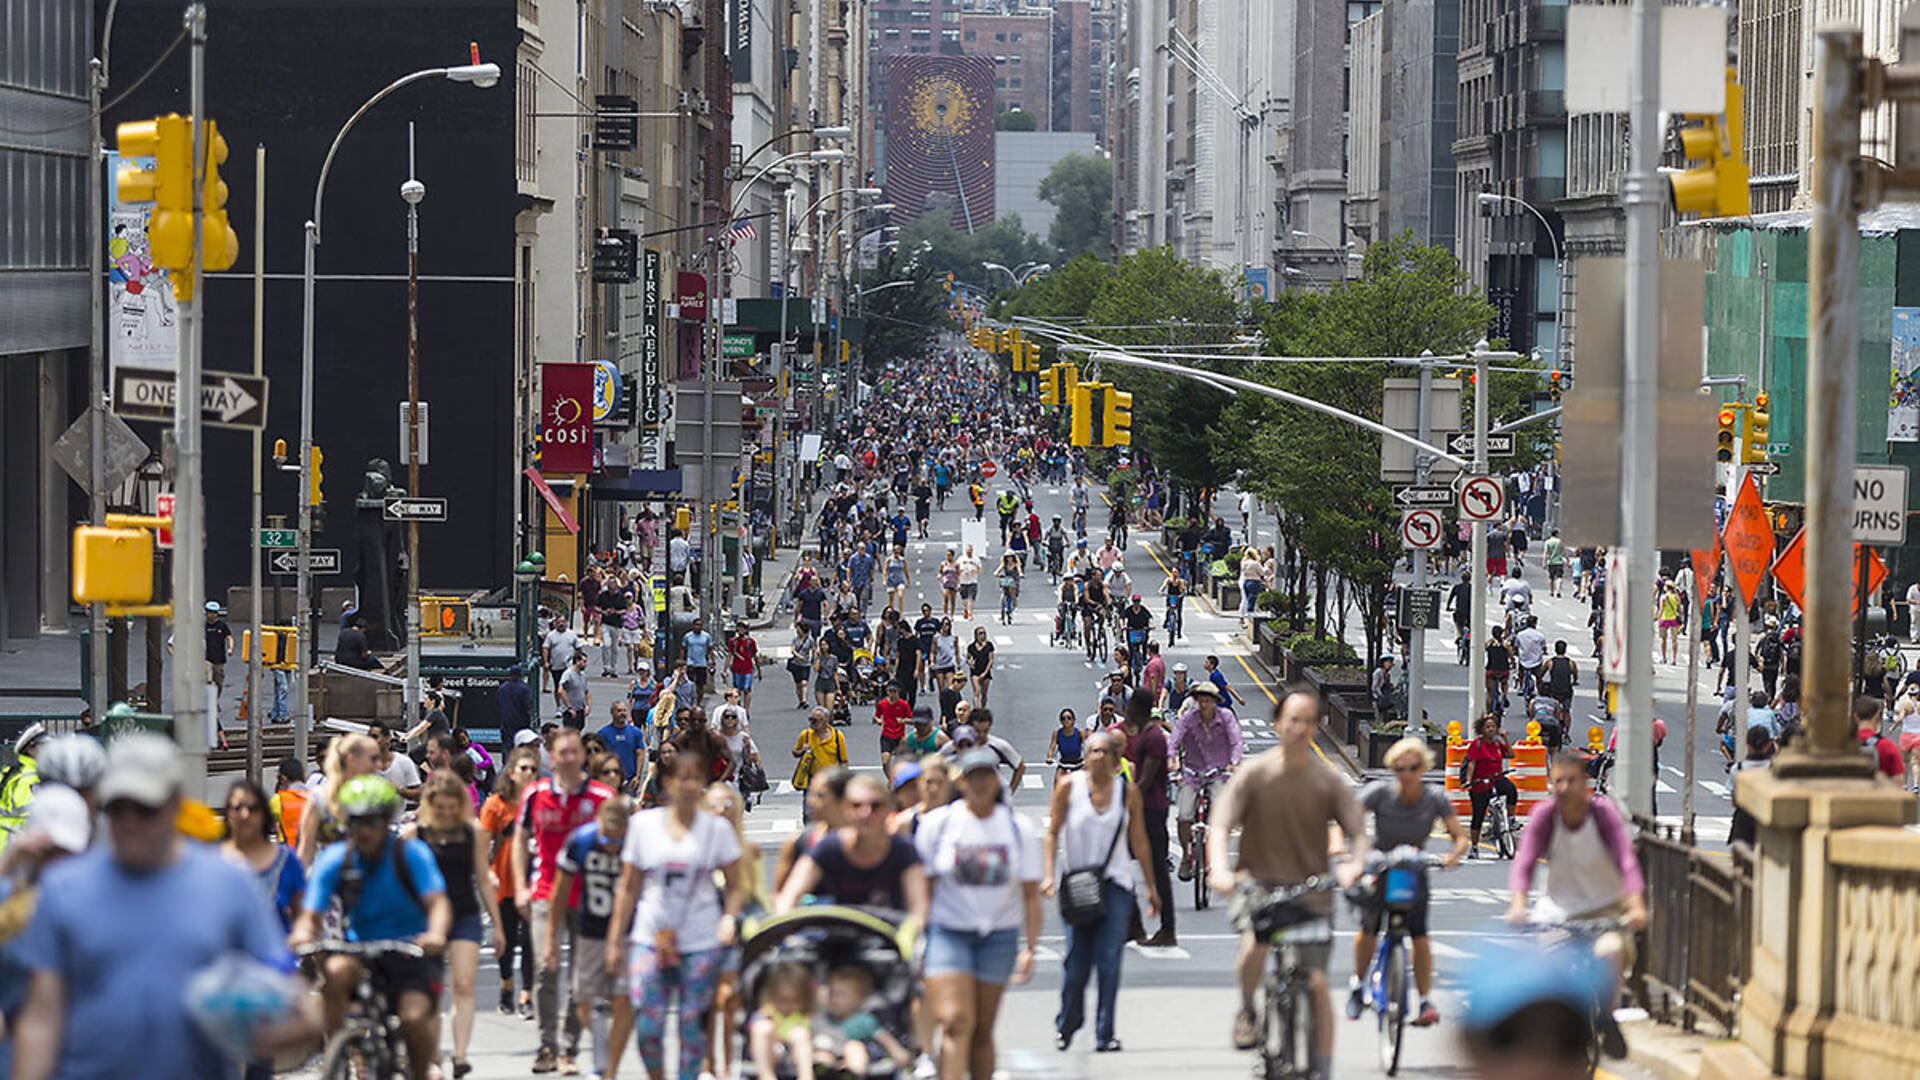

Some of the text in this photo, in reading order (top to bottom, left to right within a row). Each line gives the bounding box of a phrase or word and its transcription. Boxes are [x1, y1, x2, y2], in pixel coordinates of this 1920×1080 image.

[645, 253, 657, 317] FIRST
[643, 324, 658, 422] REPUBLIC
[136, 383, 242, 410] ONE WAY
[1456, 439, 1474, 449] ONE
[1854, 479, 1885, 501] NO
[266, 531, 282, 545] 32
[466, 677, 500, 687] Station
